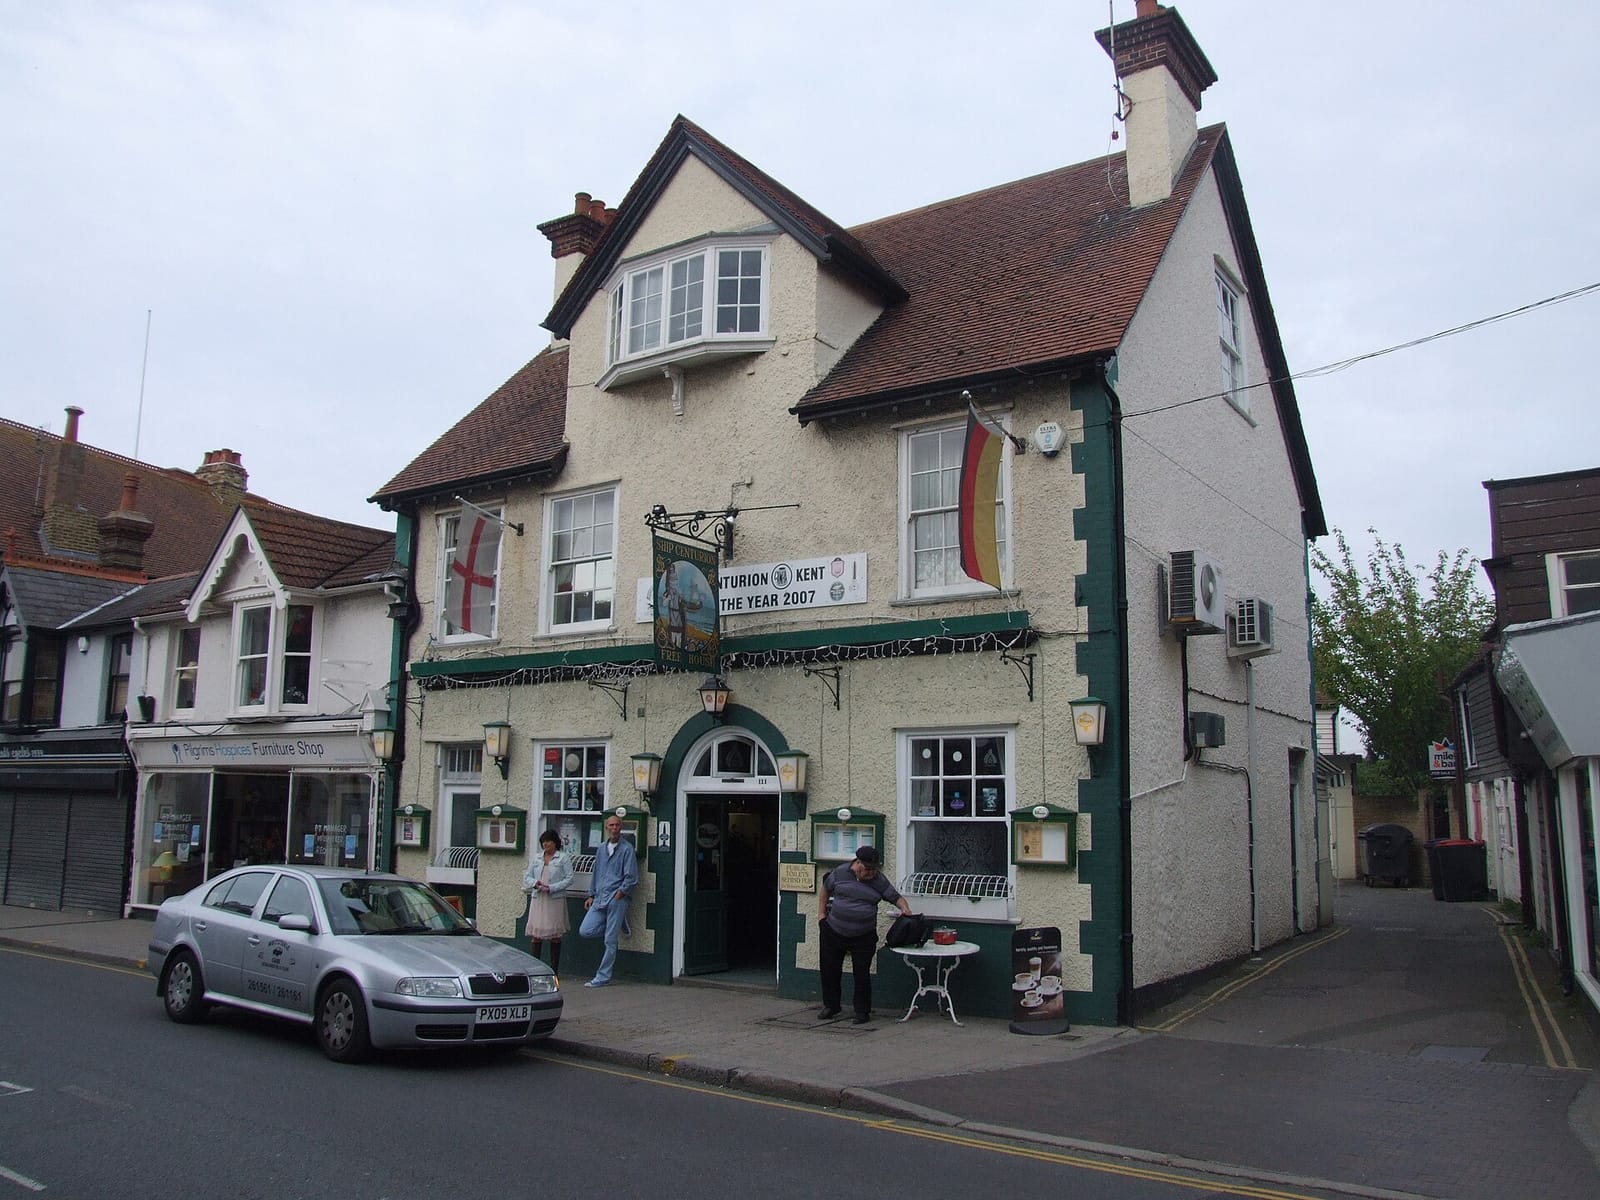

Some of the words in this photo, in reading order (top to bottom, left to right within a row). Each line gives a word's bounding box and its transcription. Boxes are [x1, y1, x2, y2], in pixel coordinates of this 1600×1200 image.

[656, 541, 673, 553] SHIP
[675, 545, 716, 565] CENTURION
[796, 566, 826, 582] KENT
[720, 598, 743, 611] THE
[747, 593, 778, 609] YEAR
[783, 590, 816, 605] 2007
[661, 650, 681, 662] FREE
[688, 654, 717, 668] HOUSE
[183, 743, 215, 760] Pilgrims
[215, 743, 251, 761] Hospices
[252, 741, 295, 756] Furniture
[298, 740, 324, 758] Shop
[480, 1007, 508, 1021] PX09
[509, 1006, 528, 1019] XLB
